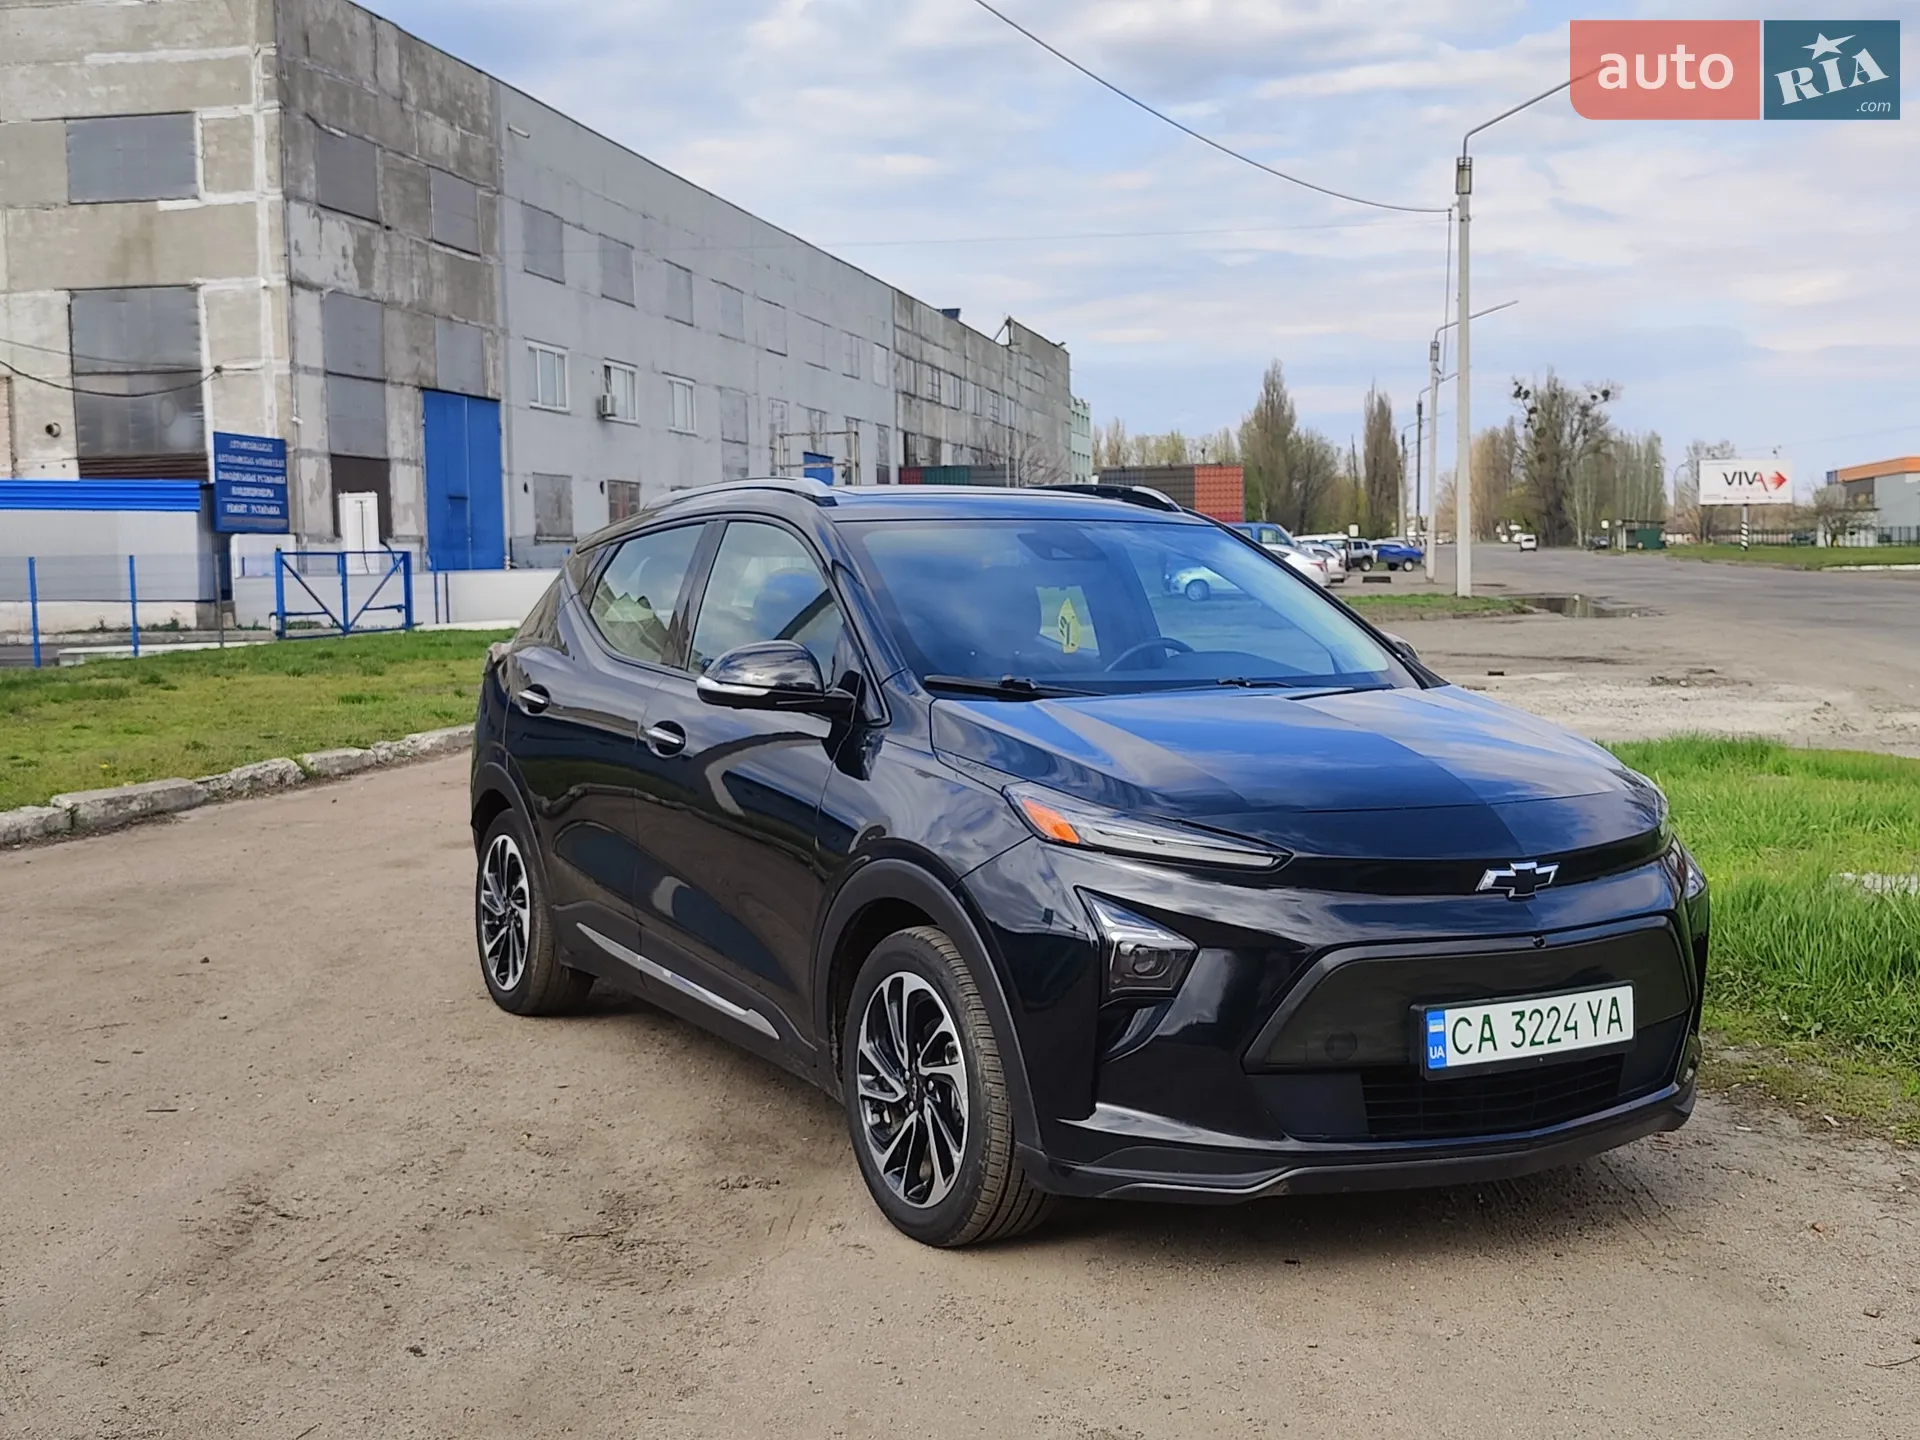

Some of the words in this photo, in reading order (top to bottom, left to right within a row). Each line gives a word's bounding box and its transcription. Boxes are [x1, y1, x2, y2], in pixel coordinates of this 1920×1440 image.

[1722, 470, 1769, 493] VIVA
[1451, 1013, 1498, 1055] CA
[1510, 1002, 1579, 1049] 3224
[1587, 995, 1624, 1037] YA
[1429, 1045, 1445, 1060] UA
